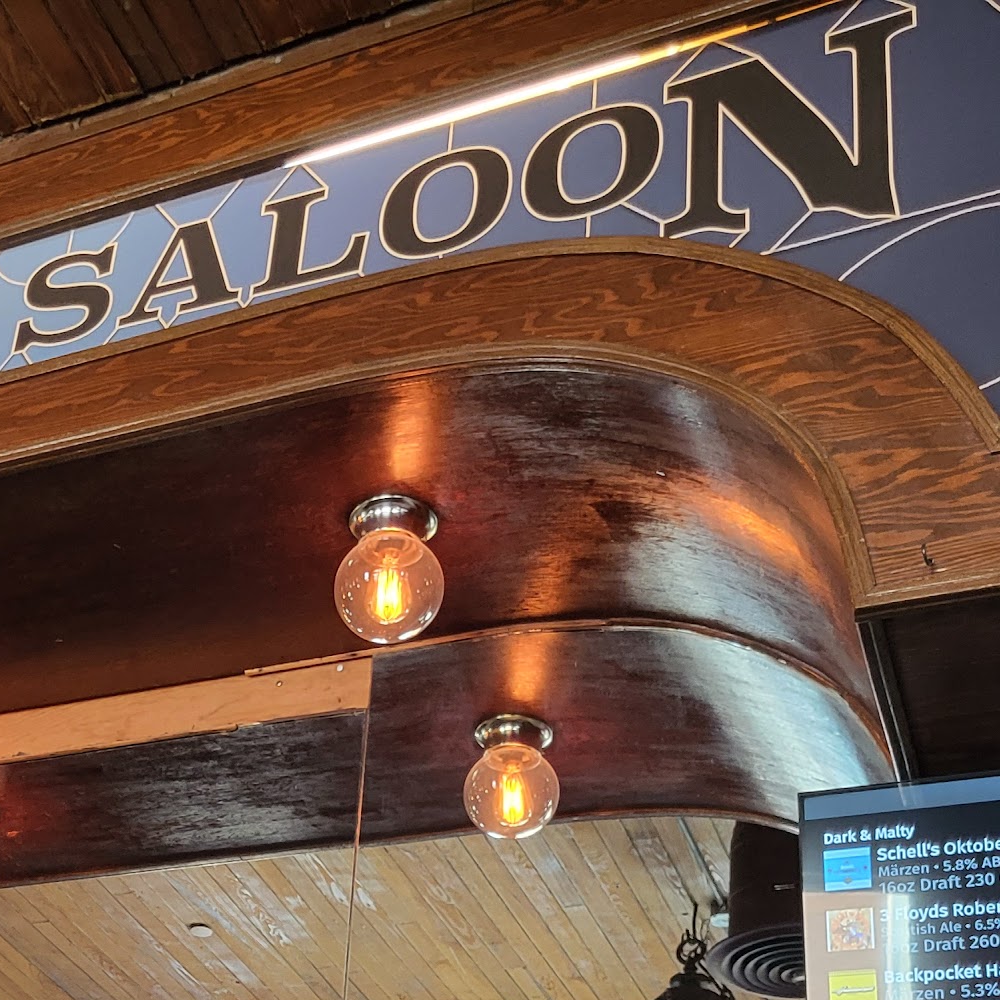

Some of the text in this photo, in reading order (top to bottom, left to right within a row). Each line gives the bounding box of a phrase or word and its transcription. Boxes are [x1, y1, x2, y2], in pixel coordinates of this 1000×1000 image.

[14, 8, 916, 352] SALOON
[823, 825, 915, 845] Dark & Malty
[876, 843, 940, 861] Schell's
[878, 864, 930, 877] Märzen
[942, 858, 978, 872] 5.8%
[878, 873, 995, 894] 16oz Draft 230
[894, 903, 948, 922] Floyds
[939, 922, 962, 934] Ale
[923, 934, 1000, 952] Draft 260
[884, 965, 982, 984] Backpocket
[960, 982, 1000, 998] 5.3%
